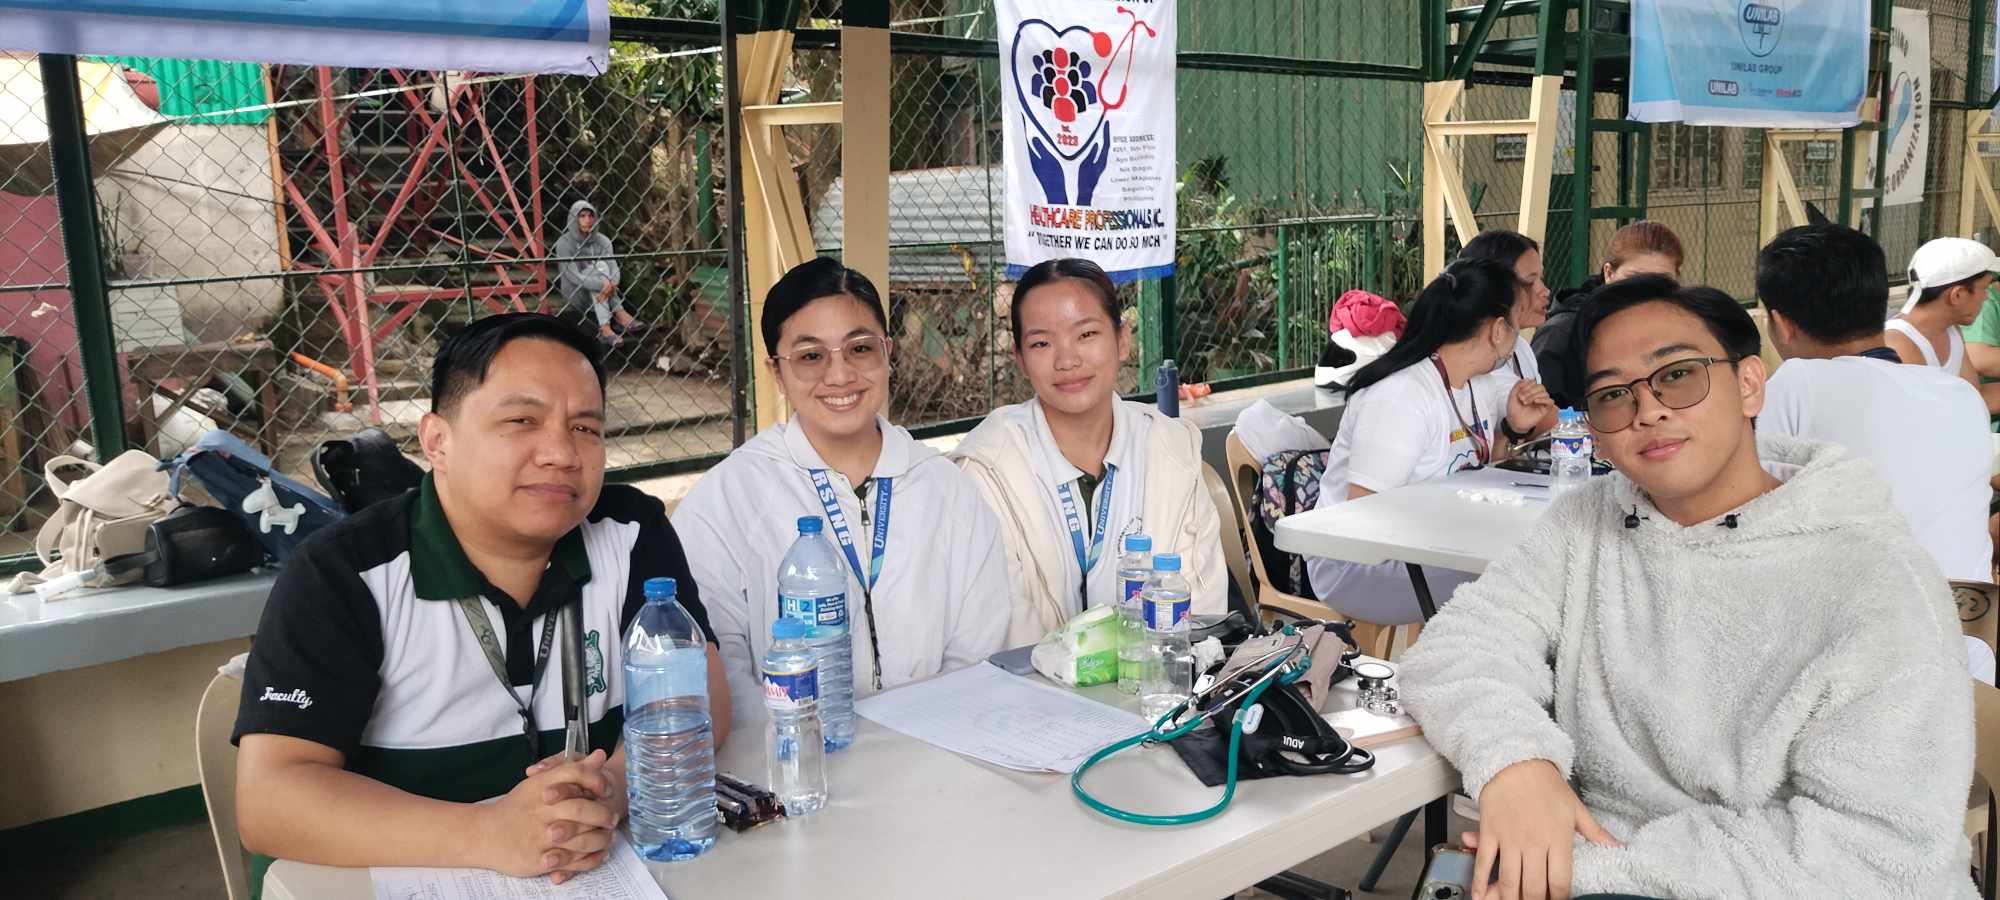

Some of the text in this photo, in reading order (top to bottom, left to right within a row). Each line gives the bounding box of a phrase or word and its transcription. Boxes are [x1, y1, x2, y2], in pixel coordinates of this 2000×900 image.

[1759, 64, 1783, 75] GROUP
[1074, 236, 1091, 250] WE
[1094, 236, 1113, 250] CAN
[1115, 237, 1128, 250] DO
[259, 686, 313, 709] Faculty
